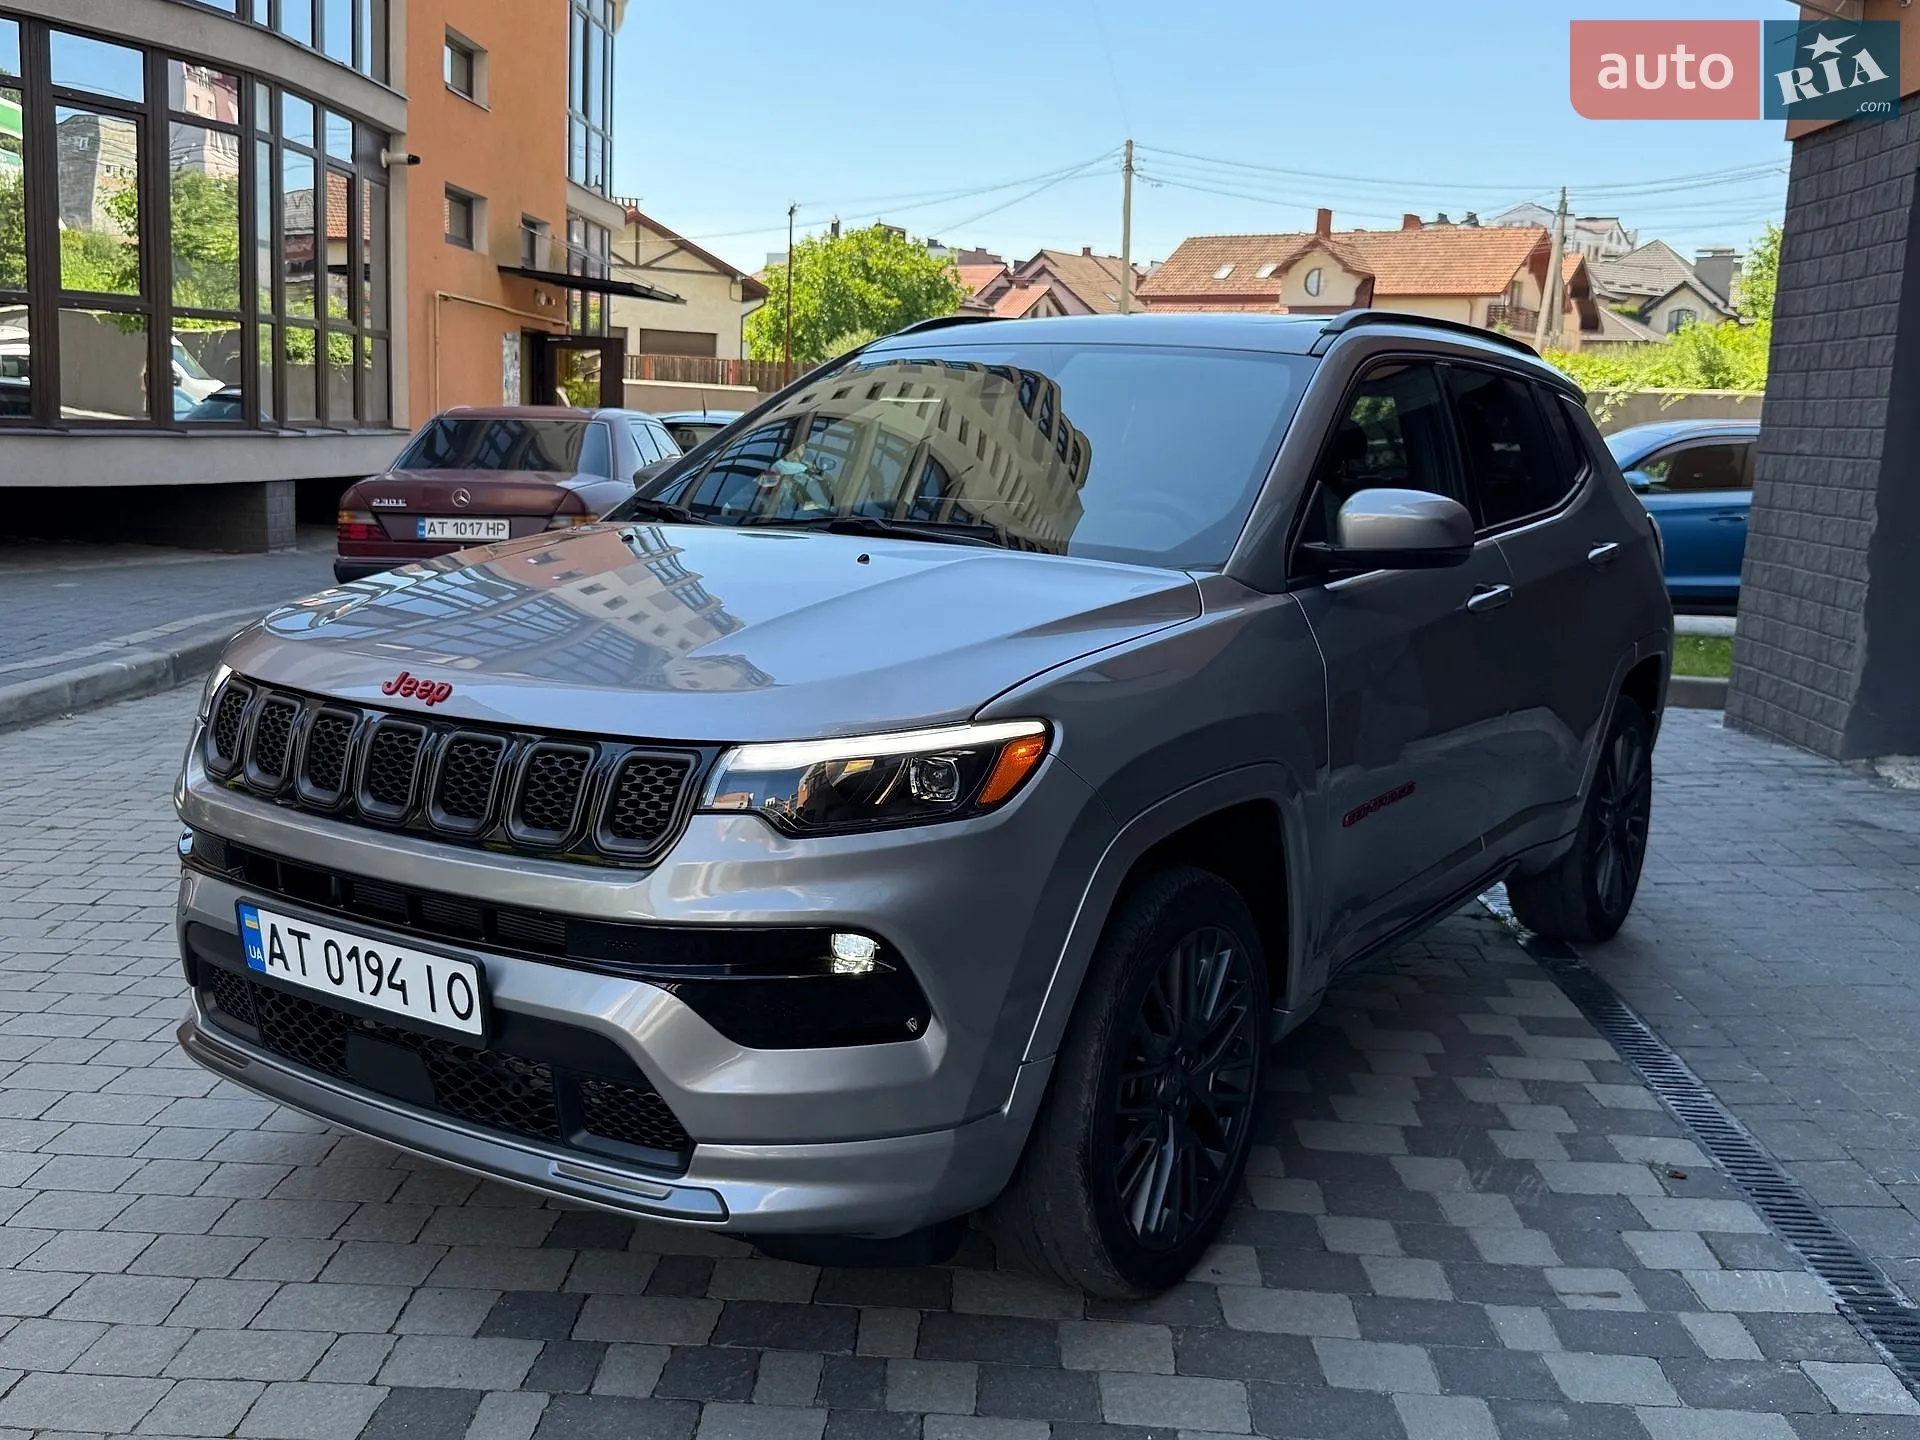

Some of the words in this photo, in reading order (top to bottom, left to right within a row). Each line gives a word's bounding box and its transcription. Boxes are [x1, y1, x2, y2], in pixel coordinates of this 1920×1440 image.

[427, 521, 448, 535] AT
[453, 522, 483, 536] 1017
[486, 522, 506, 536] HP
[381, 671, 453, 707] Jeep
[248, 944, 265, 962] UA
[268, 923, 311, 977] AT
[323, 939, 409, 1006] 0194
[426, 964, 474, 1021] IO
